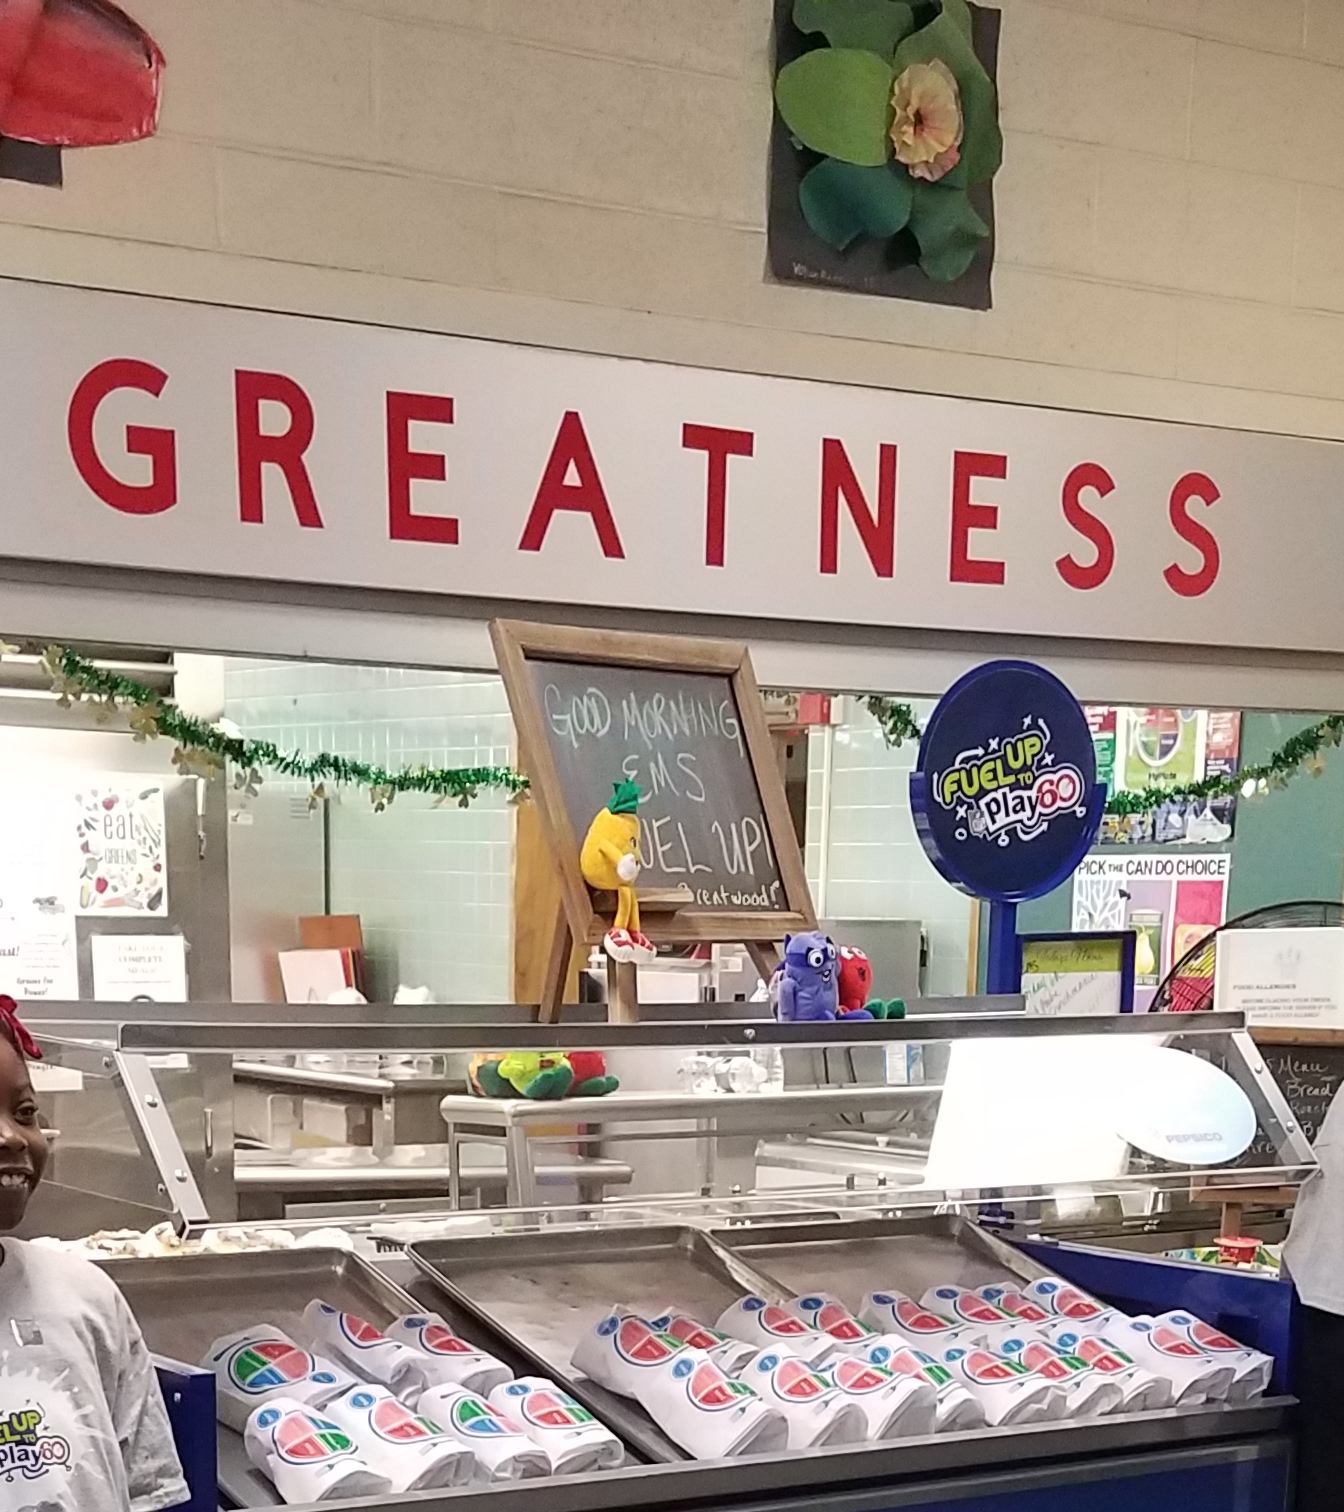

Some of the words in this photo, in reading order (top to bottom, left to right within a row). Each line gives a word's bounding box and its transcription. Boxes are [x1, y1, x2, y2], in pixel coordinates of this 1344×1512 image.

[67, 358, 1221, 598] GREATNESS
[544, 684, 612, 749] GOOD
[943, 758, 1016, 804] FUEL
[1006, 736, 1042, 770] UP
[1017, 771, 1033, 787] TO
[103, 811, 136, 840] eat
[104, 847, 138, 865] GREENS
[638, 816, 712, 874] UEL
[1078, 859, 1107, 876] PICK
[1108, 863, 1124, 873] THE
[1126, 859, 1155, 875] CAN
[1155, 859, 1175, 875] DO
[1176, 859, 1227, 875] CHOICE
[677, 879, 780, 909] rentwood!
[1165, 1132, 1223, 1144] PEPSICO
[10, 1411, 42, 1431] UP
